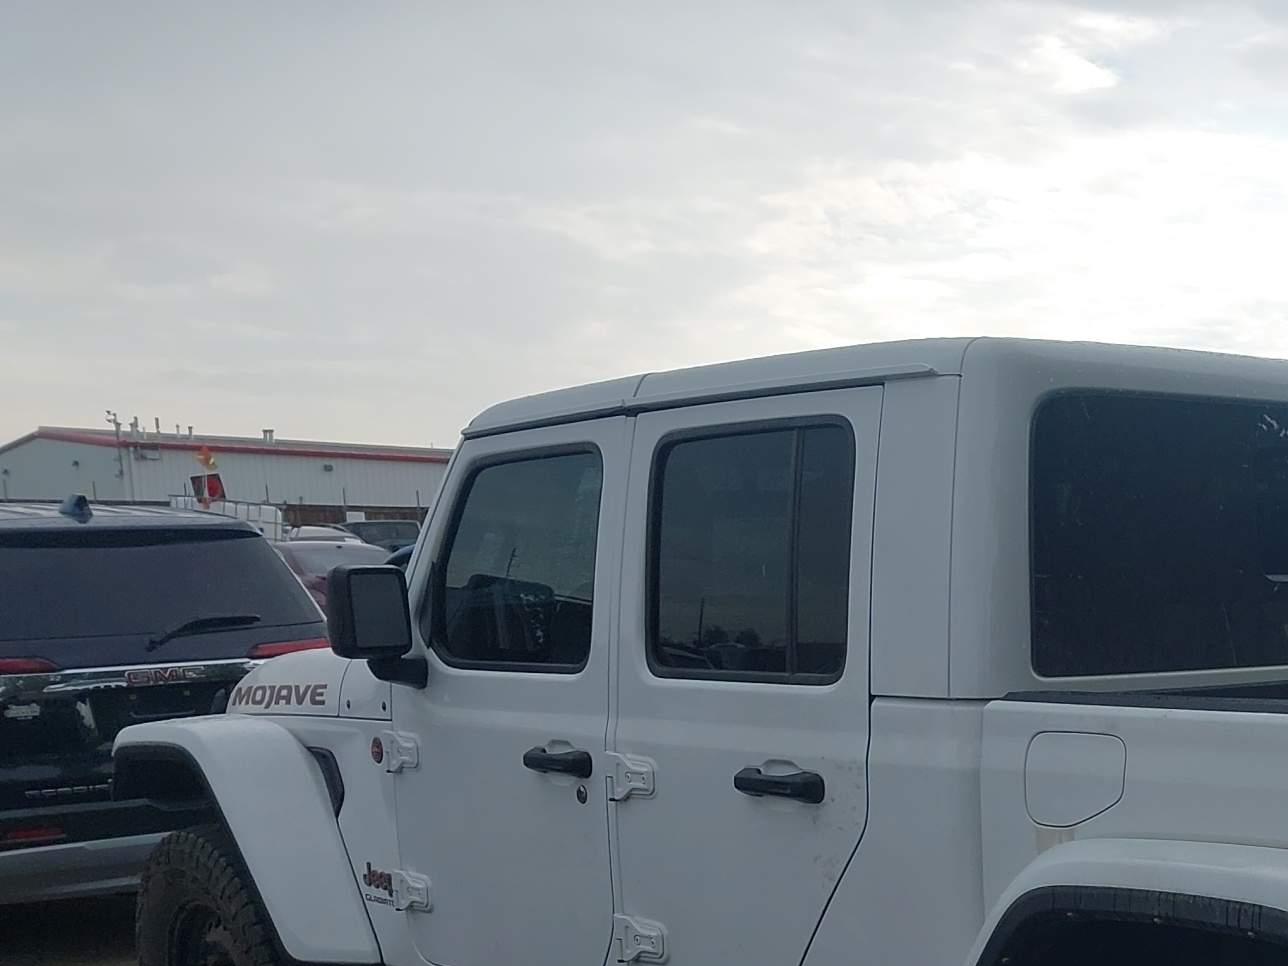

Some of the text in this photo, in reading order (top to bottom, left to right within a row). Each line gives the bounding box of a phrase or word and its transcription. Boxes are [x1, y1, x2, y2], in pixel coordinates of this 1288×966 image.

[124, 665, 207, 687] GMC
[231, 683, 328, 710] MOJAVE
[363, 861, 394, 898] Jeep
